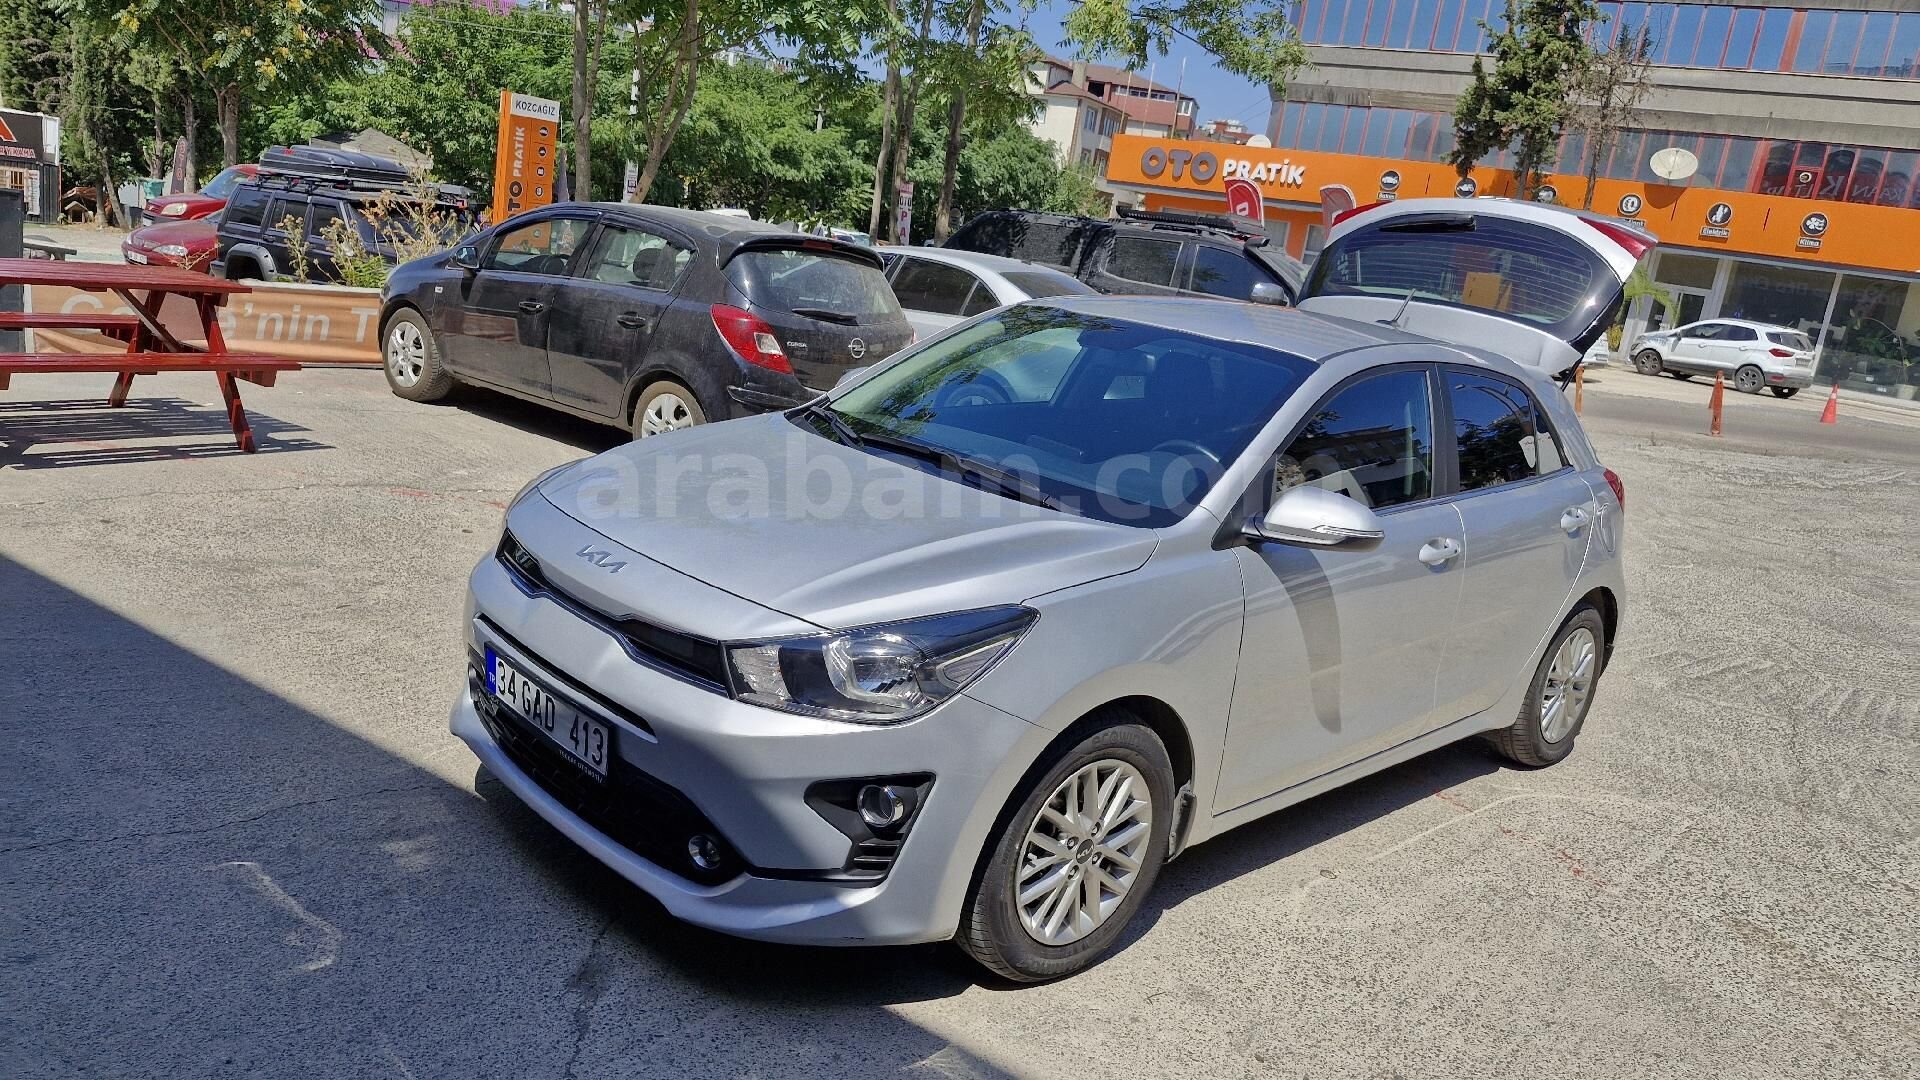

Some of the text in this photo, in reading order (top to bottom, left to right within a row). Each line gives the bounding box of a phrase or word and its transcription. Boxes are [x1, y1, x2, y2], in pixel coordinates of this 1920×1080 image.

[1141, 146, 1306, 186] OTO PRATİK
[507, 181, 523, 219] TO
[497, 659, 604, 766] 34 GAD 413
